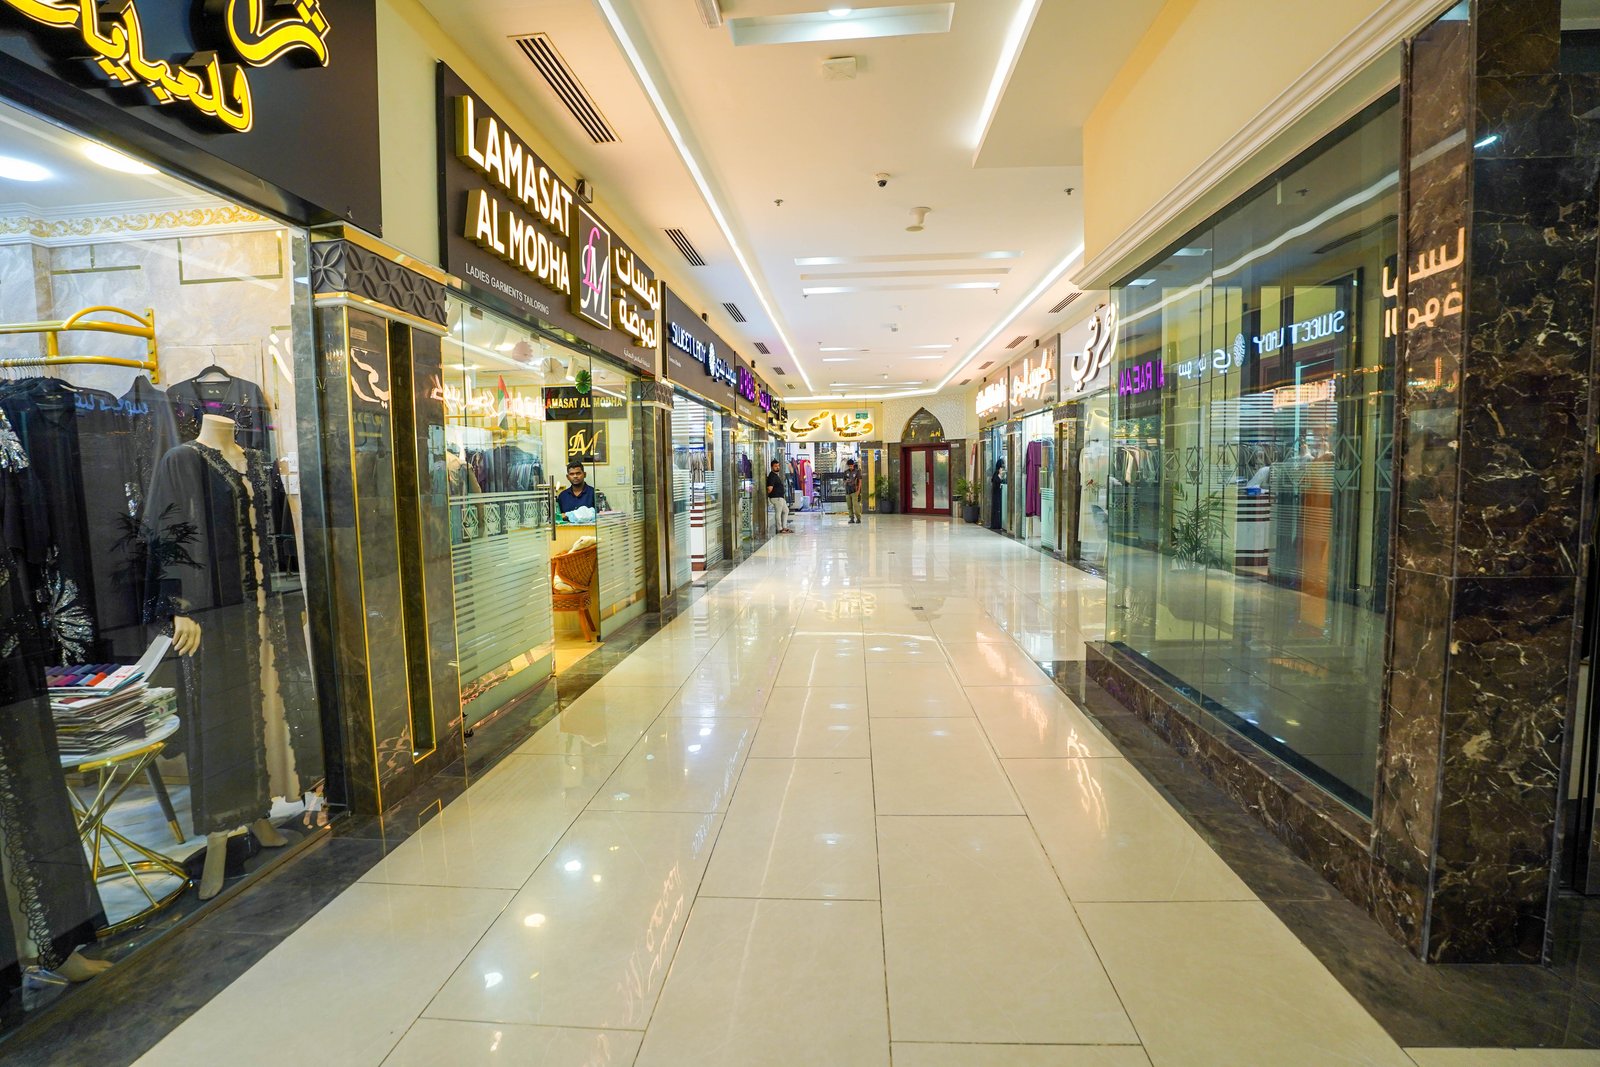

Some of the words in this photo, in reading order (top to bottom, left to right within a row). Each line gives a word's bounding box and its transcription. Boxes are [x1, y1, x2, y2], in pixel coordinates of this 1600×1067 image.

[467, 95, 573, 238] LAMASAT
[476, 189, 505, 255] AL
[508, 210, 571, 295] MODHA
[465, 262, 490, 285] LADIES
[490, 277, 523, 302] GARMENTS
[523, 294, 549, 315] TAILORING
[615, 246, 662, 311] لمسات
[671, 321, 692, 355] SWEET
[580, 397, 591, 408] AL
